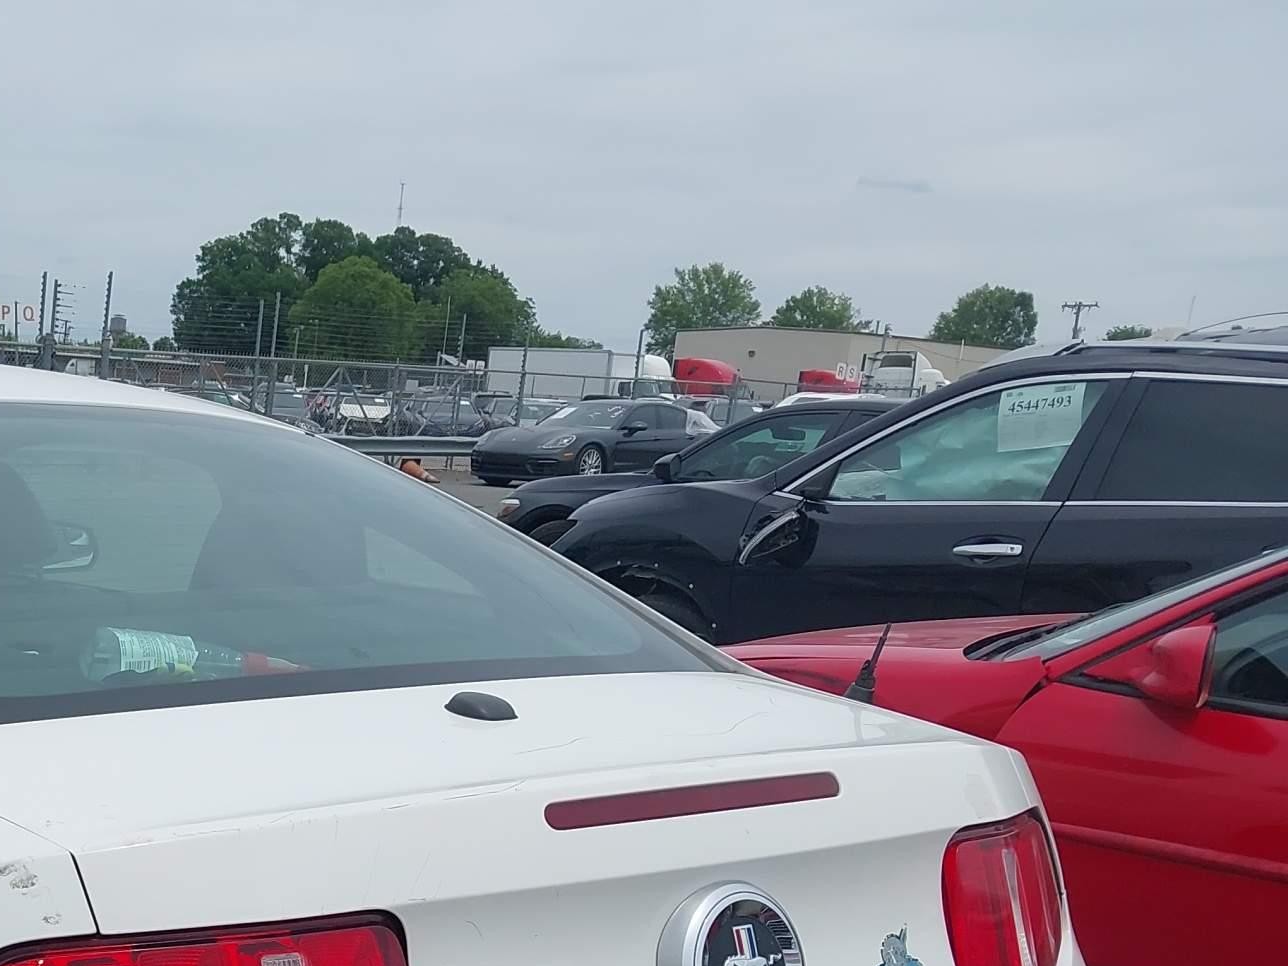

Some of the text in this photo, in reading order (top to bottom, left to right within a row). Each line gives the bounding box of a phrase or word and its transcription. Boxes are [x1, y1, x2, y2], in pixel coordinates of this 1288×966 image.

[1, 305, 10, 320] P
[23, 306, 35, 321] Q
[1007, 395, 1072, 413] 45447493
